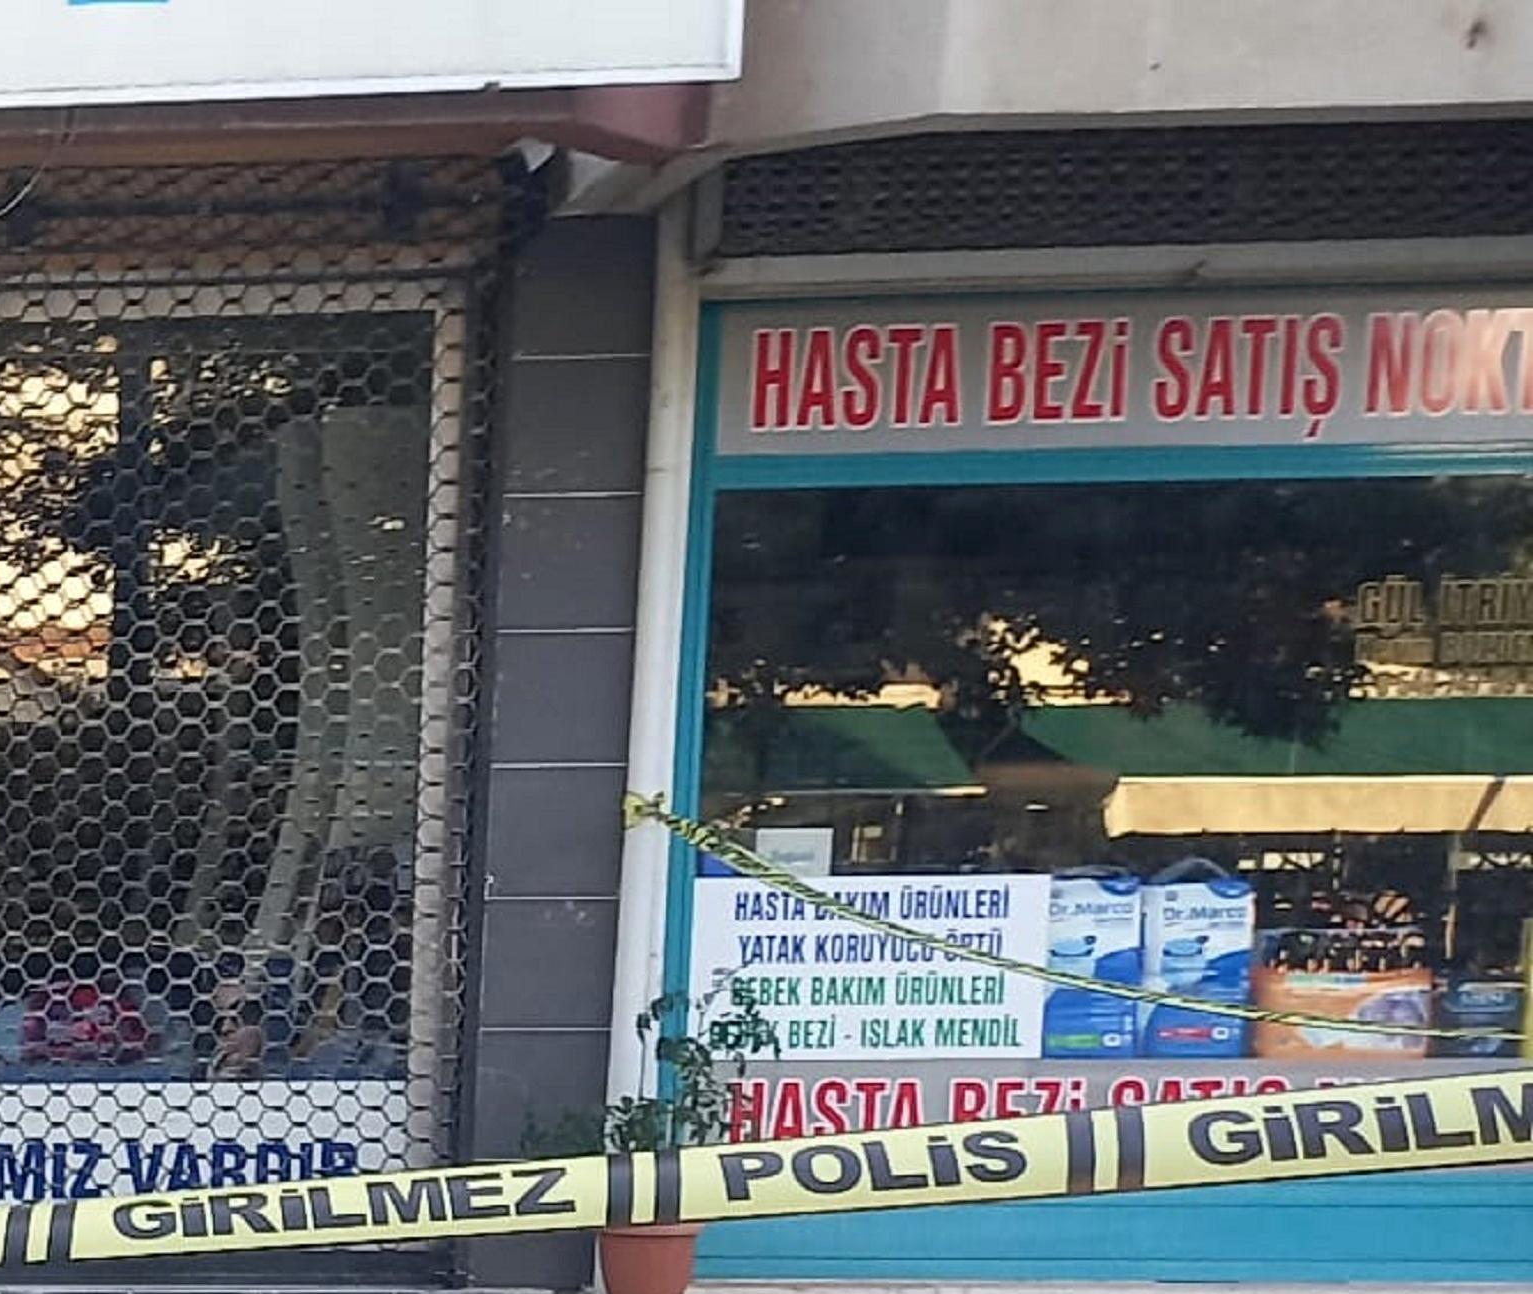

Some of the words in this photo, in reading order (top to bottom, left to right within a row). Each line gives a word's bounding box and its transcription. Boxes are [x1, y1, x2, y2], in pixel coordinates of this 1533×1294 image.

[751, 328, 960, 429] HASTA
[1155, 314, 1343, 438] SATIŞ
[734, 890, 806, 922] HASTA
[738, 934, 806, 964] YATAK
[810, 976, 885, 1006] BAKIM
[860, 1019, 926, 1048] ISLAK
